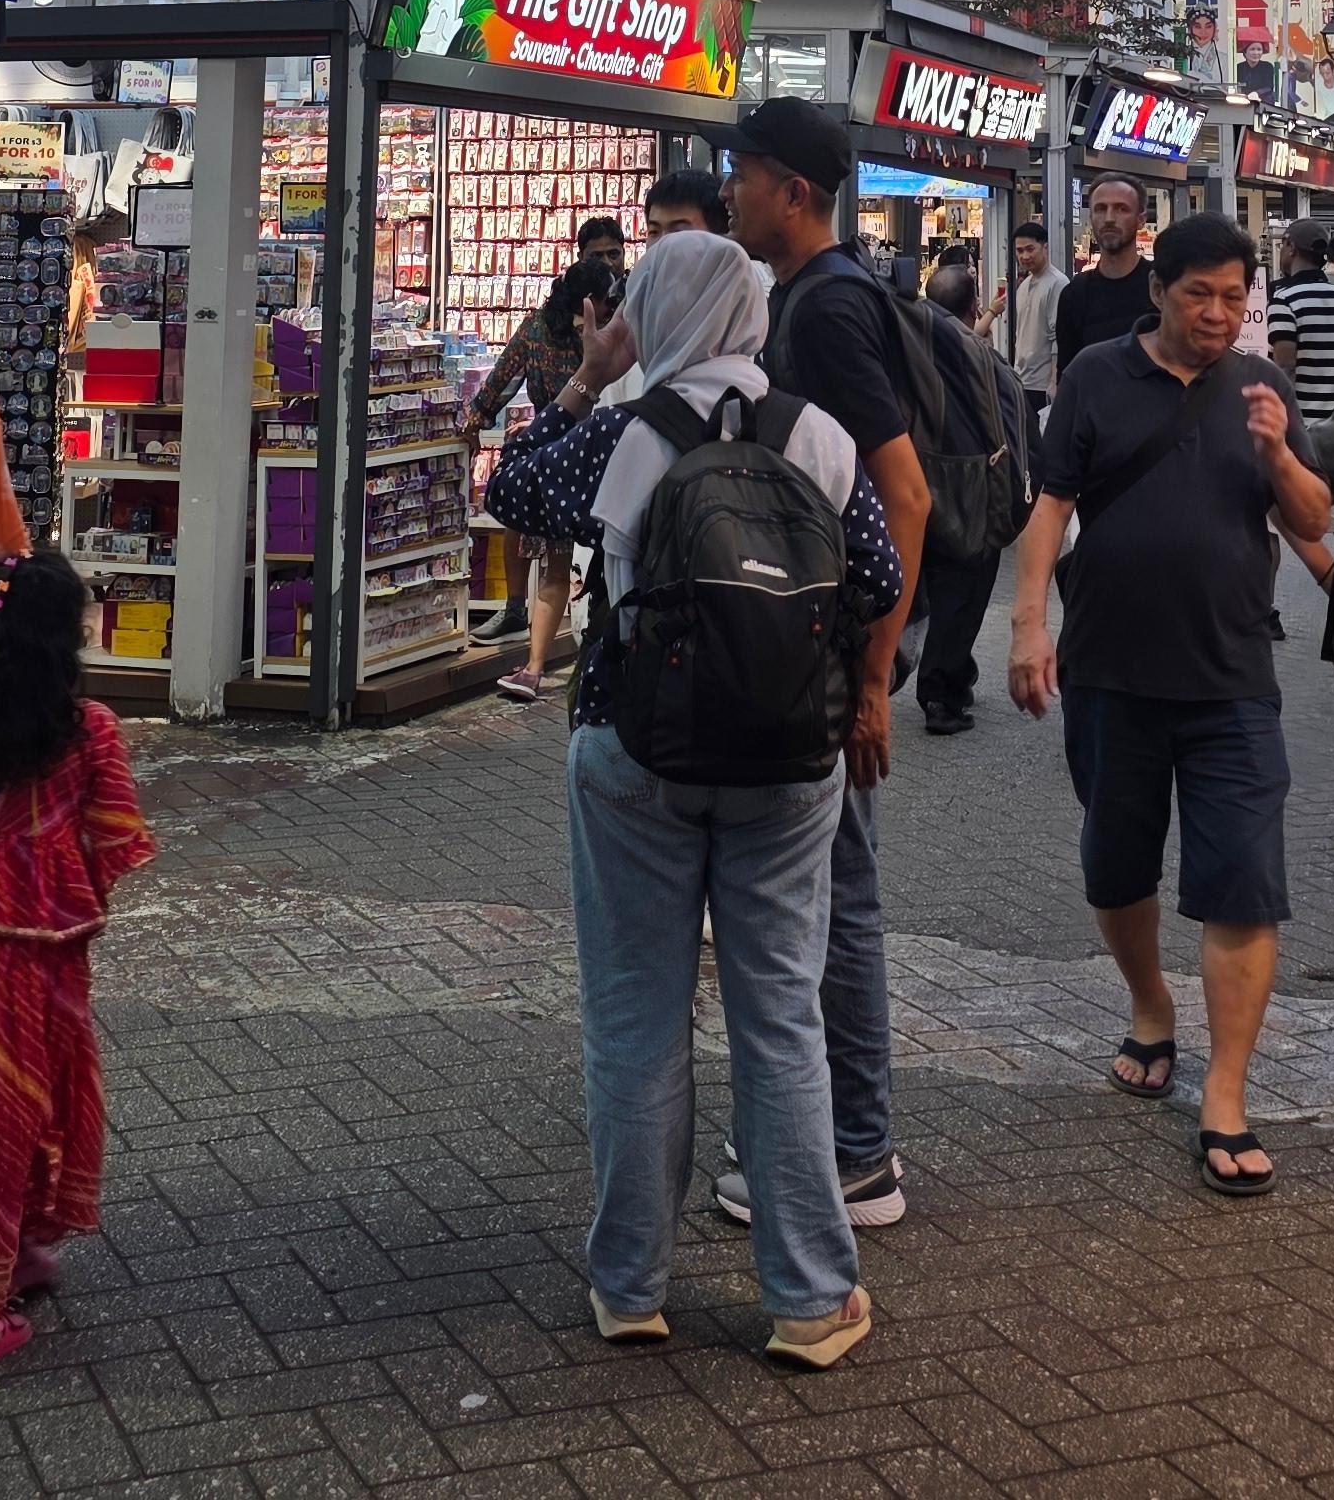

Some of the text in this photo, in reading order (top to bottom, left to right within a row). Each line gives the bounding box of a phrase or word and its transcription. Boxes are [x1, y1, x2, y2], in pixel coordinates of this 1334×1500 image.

[510, 30, 665, 84] Souvenir Chocolate Gift
[126, 78, 132, 87] 5
[133, 78, 150, 87] FOR
[897, 61, 976, 131] MIXUE
[8, 137, 30, 146] FOR
[0, 147, 30, 159] FOR
[33, 147, 56, 159] $10
[295, 189, 318, 200] FOR
